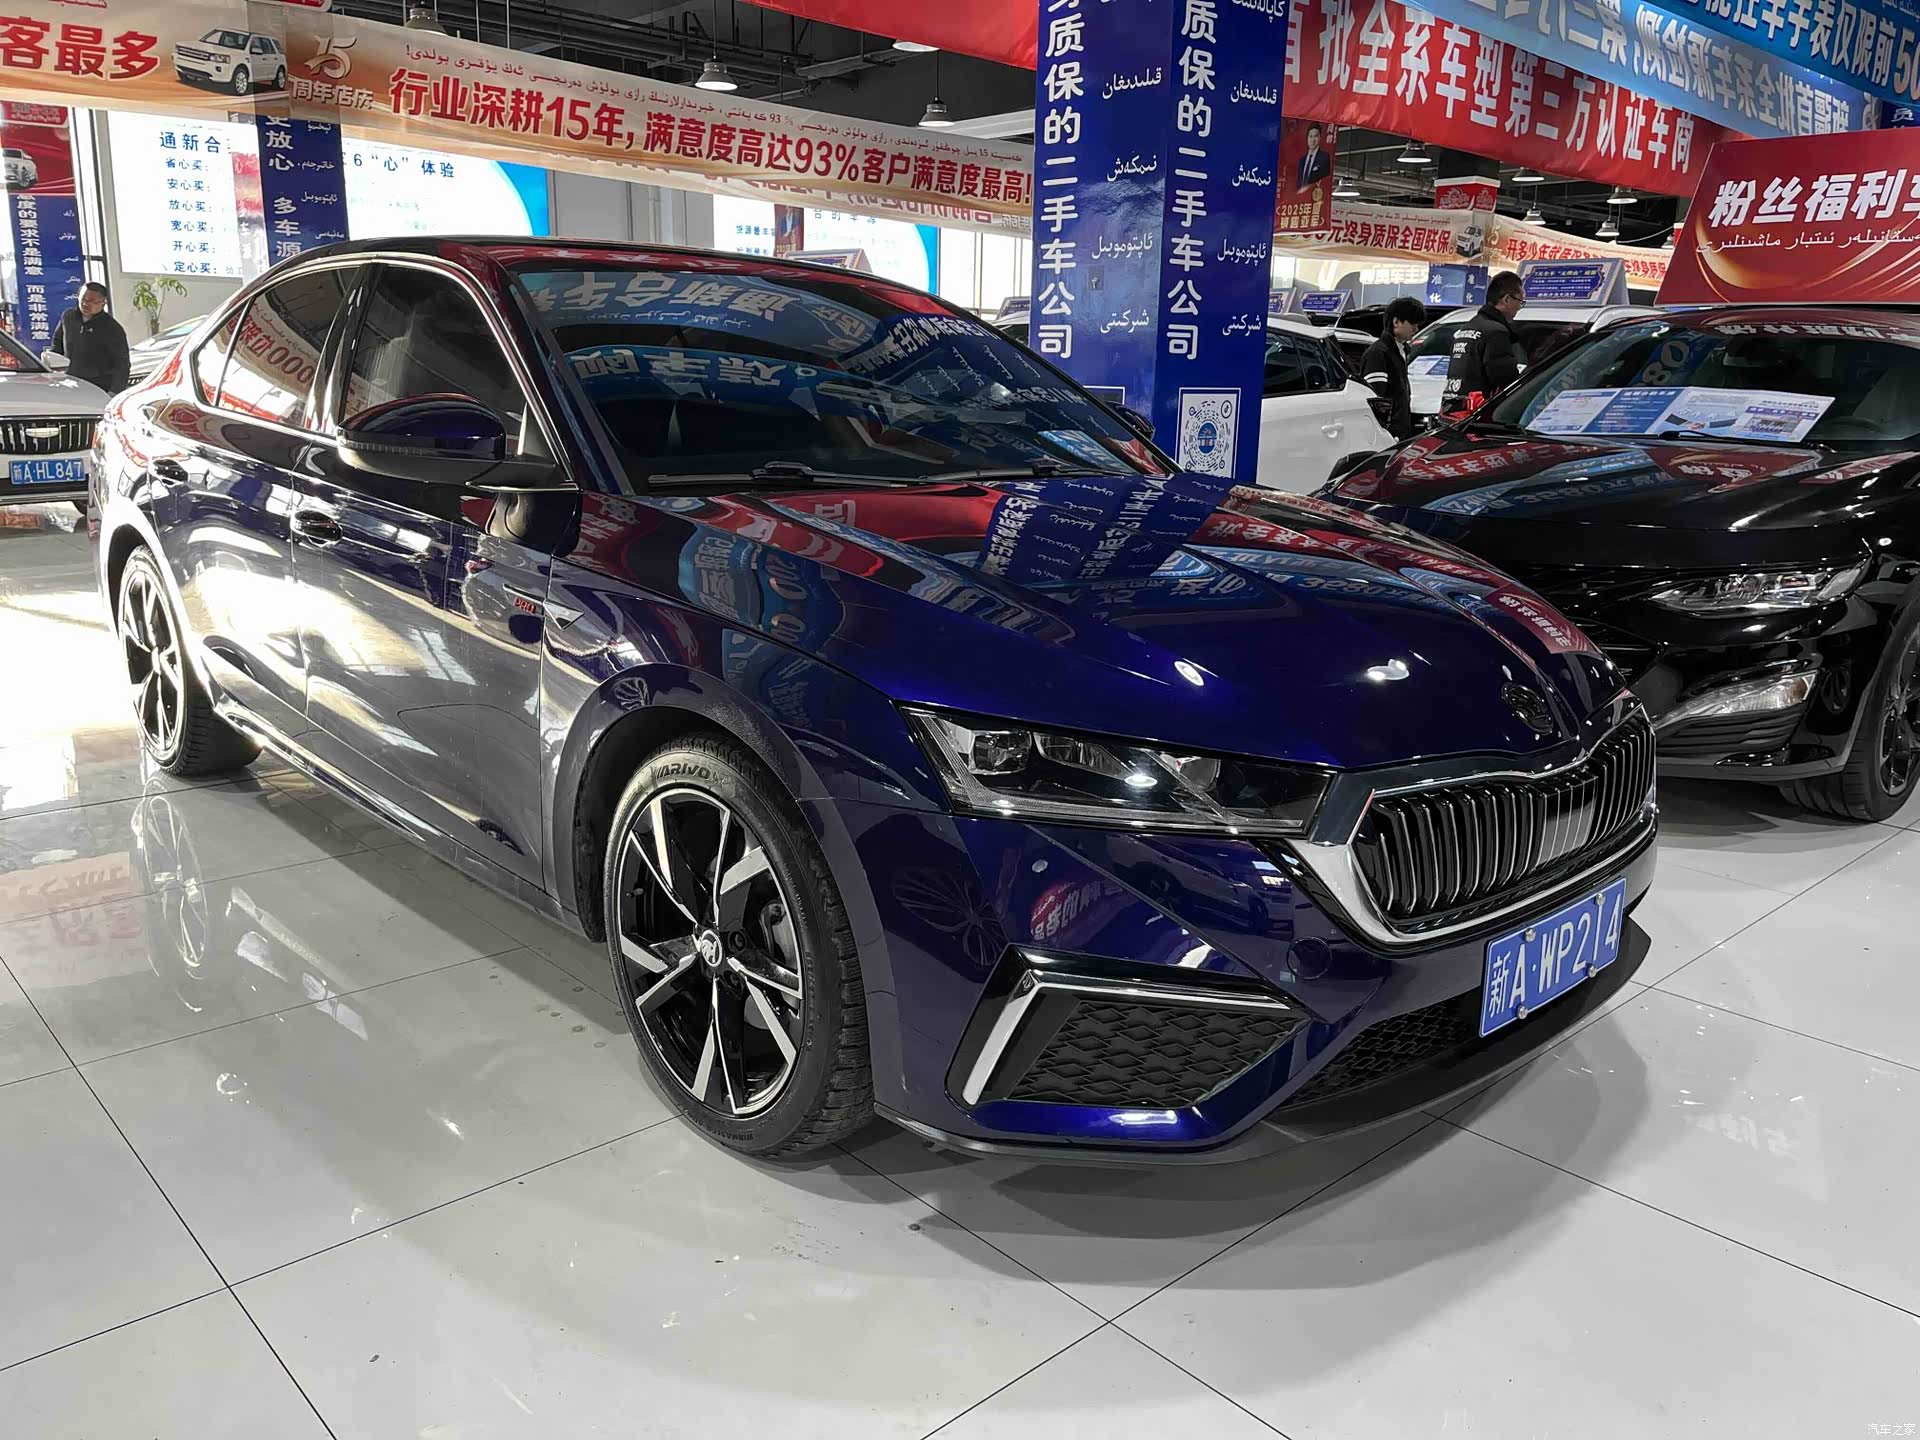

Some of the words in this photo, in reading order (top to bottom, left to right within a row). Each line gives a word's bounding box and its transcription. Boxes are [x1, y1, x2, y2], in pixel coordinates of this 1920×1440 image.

[0, 16, 159, 80] 客最多
[288, 76, 374, 111] 周年店庆
[1488, 892, 1622, 1018] 新A·WP214
